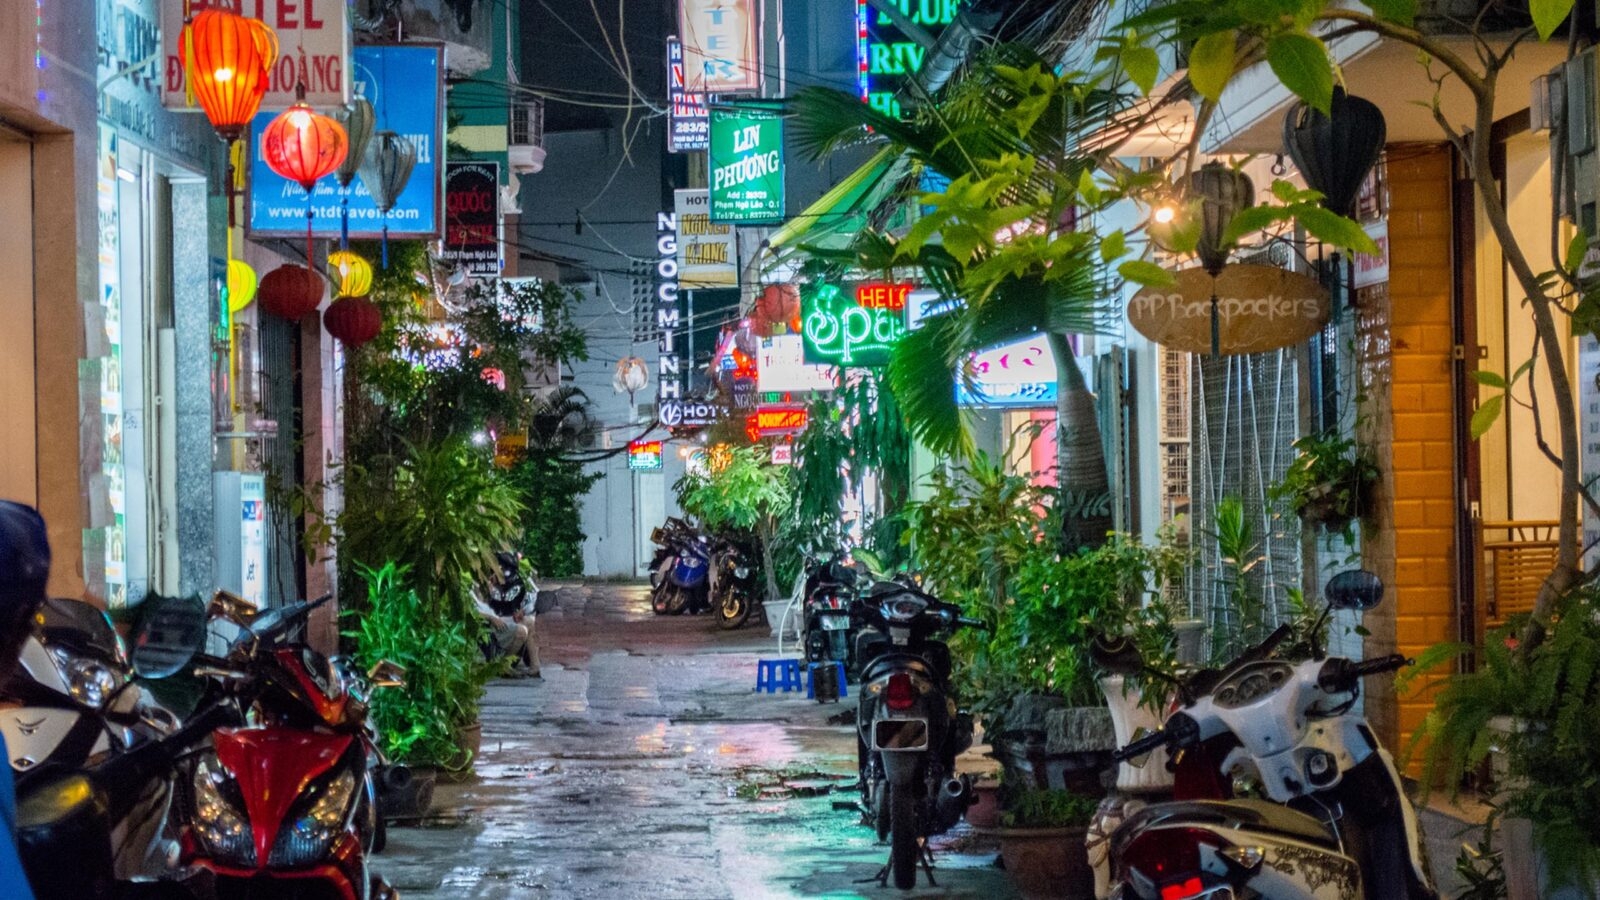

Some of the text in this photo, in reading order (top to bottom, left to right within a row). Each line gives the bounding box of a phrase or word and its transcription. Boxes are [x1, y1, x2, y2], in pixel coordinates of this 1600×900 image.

[733, 124, 760, 154] LIN
[686, 196, 708, 206] HOT
[1134, 294, 1165, 320] PP
[658, 309, 680, 399] MINH
